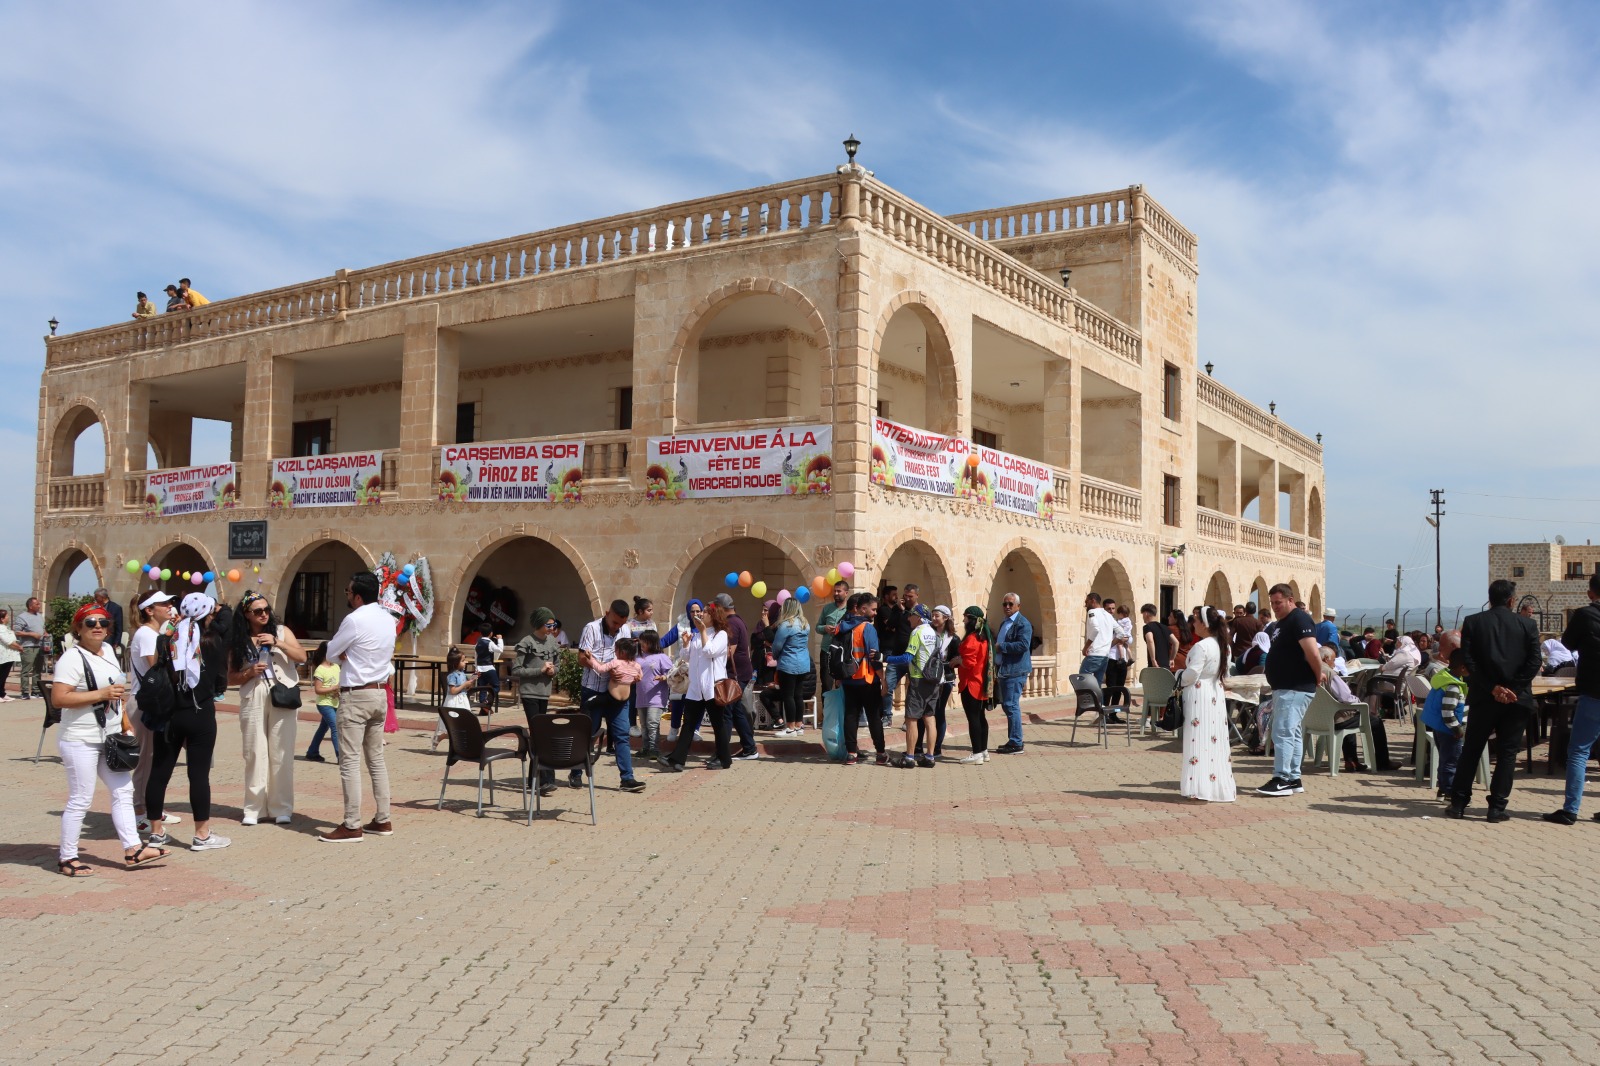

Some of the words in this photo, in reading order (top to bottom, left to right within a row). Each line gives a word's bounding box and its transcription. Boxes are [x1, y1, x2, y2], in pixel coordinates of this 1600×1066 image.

[790, 431, 817, 447] LA
[875, 419, 914, 445] ROTER
[914, 433, 970, 454] MITTWOCH
[445, 444, 538, 466] ÇARŞEMBA
[541, 444, 579, 459] SOR
[708, 455, 740, 471] FÊTE
[742, 456, 761, 470] DE
[306, 454, 377, 475] ÇARŞAMBA
[479, 463, 517, 482] PÎROZ
[521, 465, 538, 482] BE
[904, 460, 926, 476] FROHES
[926, 464, 940, 478] FEST
[1003, 456, 1050, 483] ÇARŞAMBA
[150, 471, 179, 486] ROTER
[180, 463, 232, 481] MITTWOCH
[299, 476, 323, 489] KUTLU
[325, 475, 351, 488] OLSUN
[743, 473, 782, 488] ROUGE
[490, 484, 502, 499] XÊR
[999, 475, 1017, 492] KUTLU
[1017, 481, 1035, 497] OLSUN
[192, 490, 204, 501] FEST
